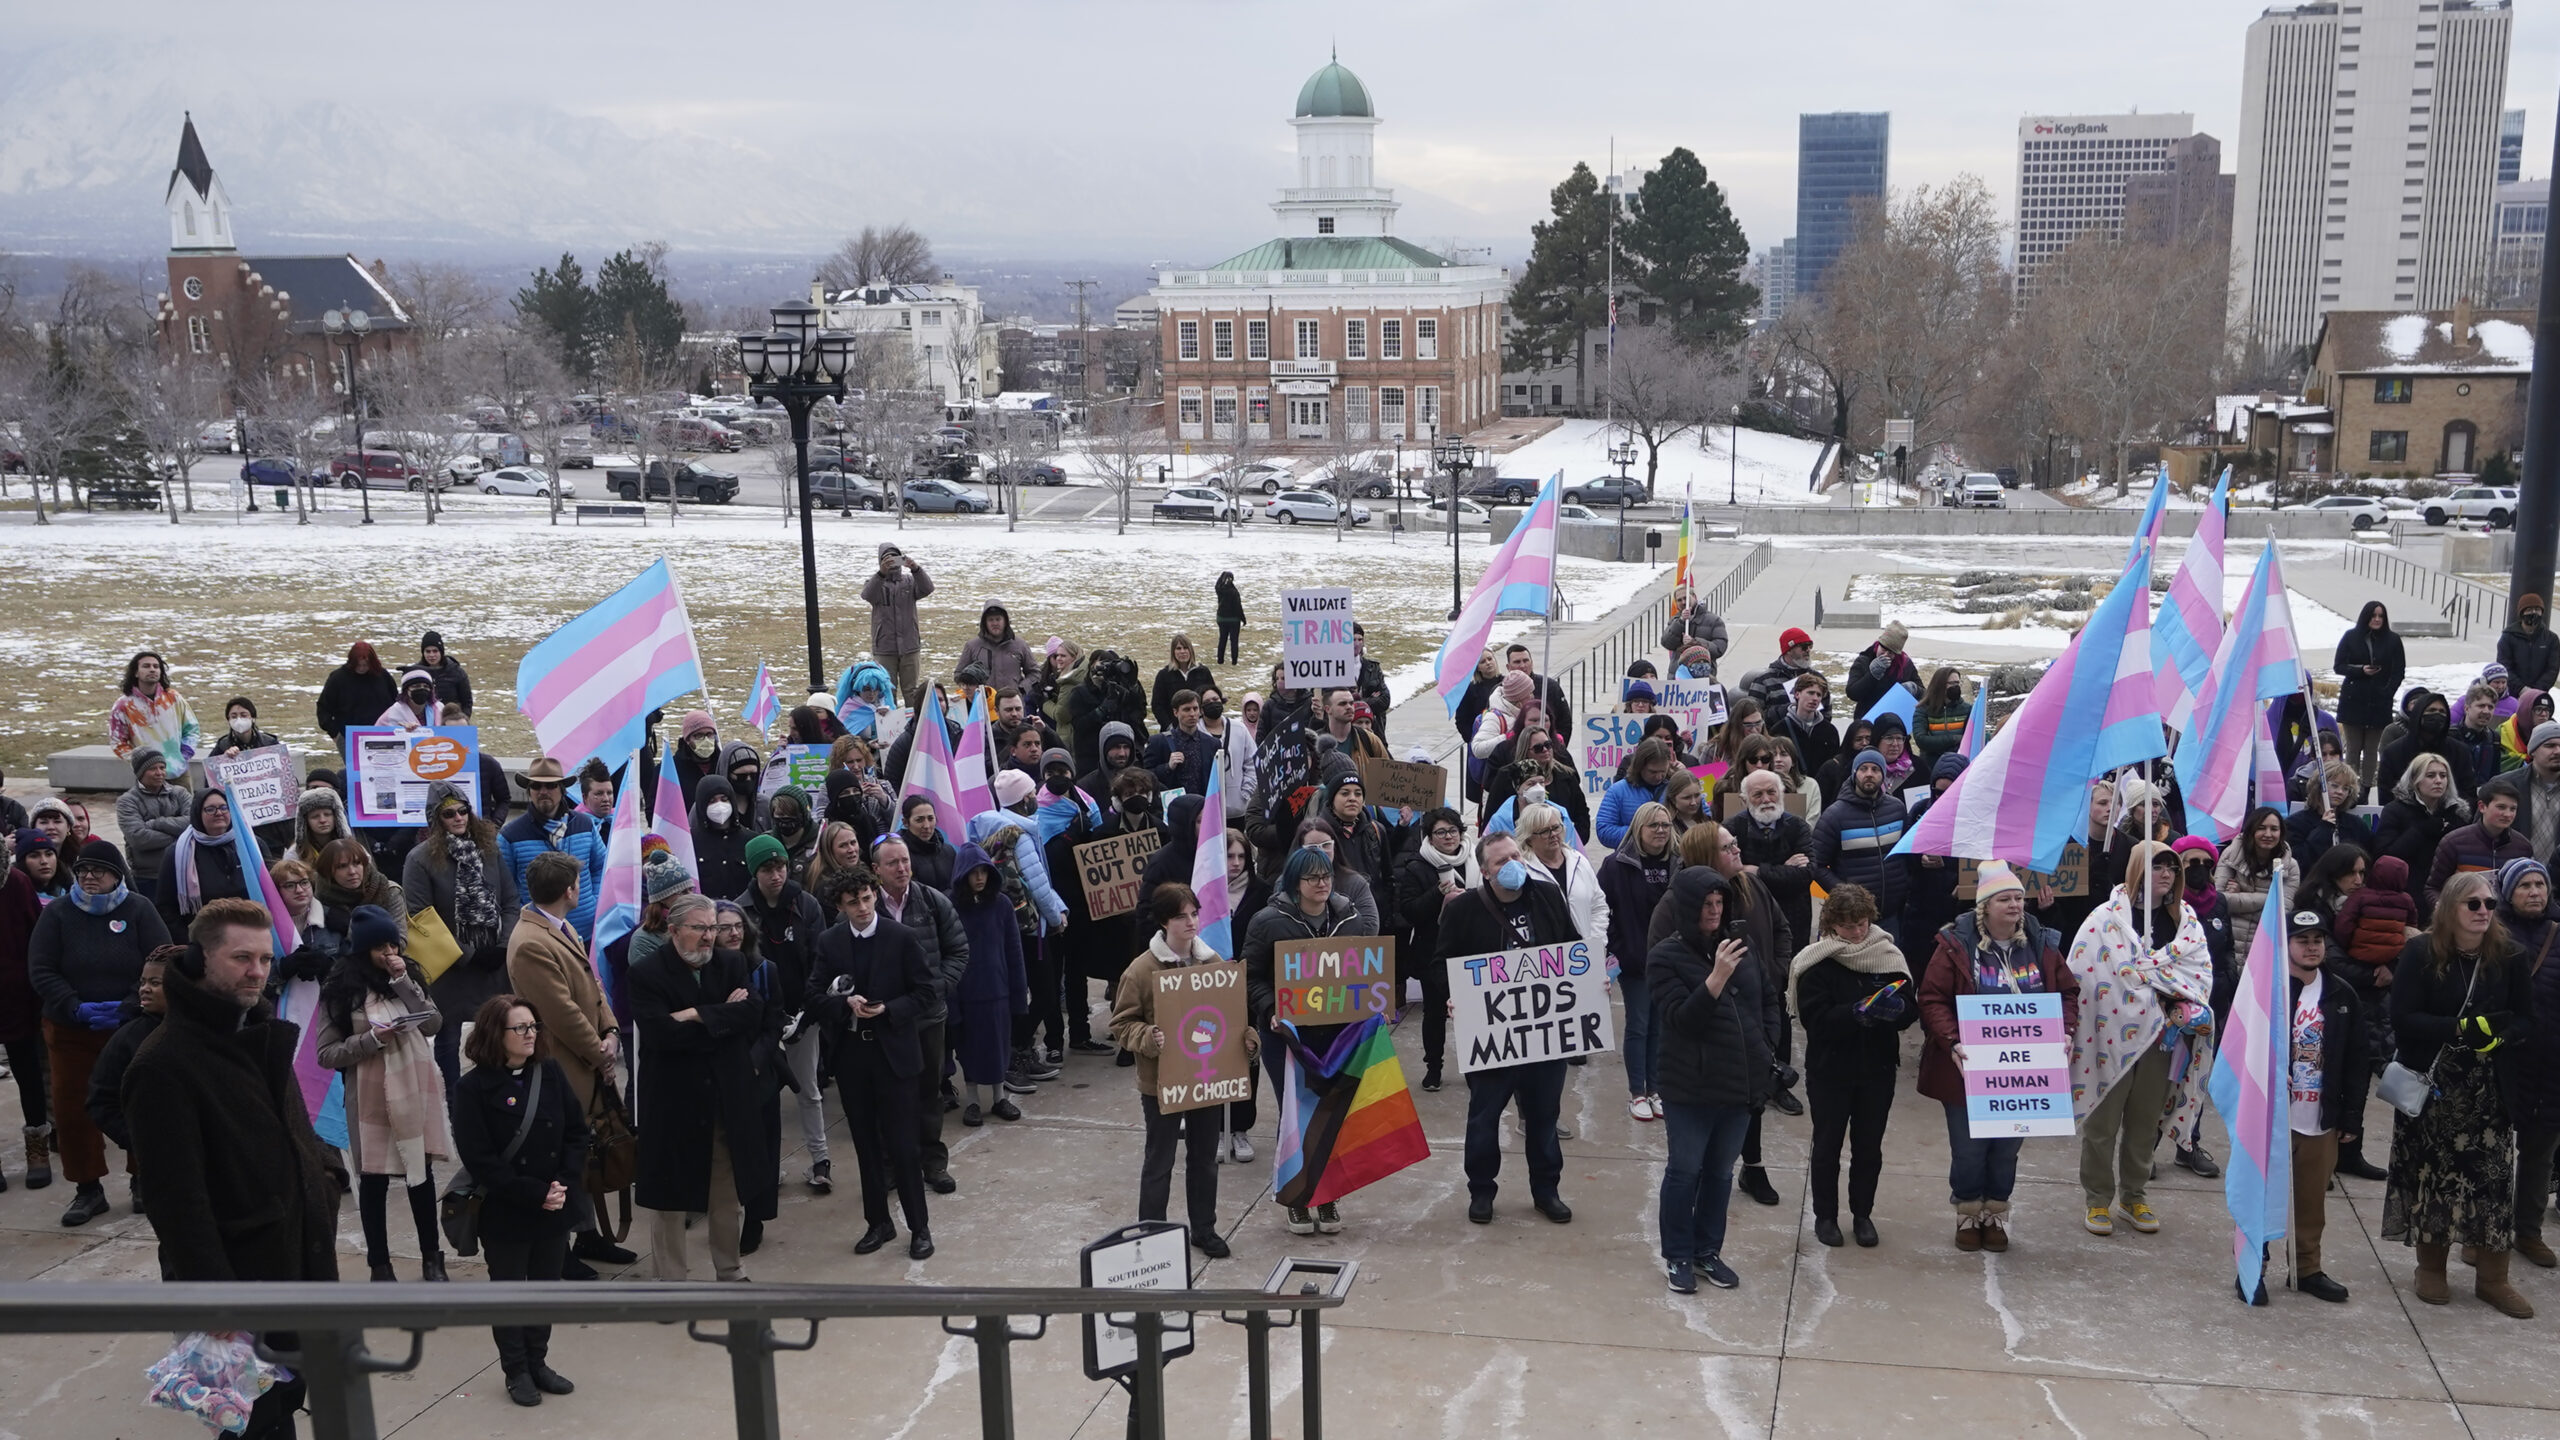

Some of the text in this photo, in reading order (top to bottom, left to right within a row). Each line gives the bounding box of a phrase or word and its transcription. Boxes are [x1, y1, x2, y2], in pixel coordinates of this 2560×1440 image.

[2055, 123, 2108, 136] KeyBank
[1215, 389, 1234, 397] GIFTS
[1288, 597, 1347, 612] VALIDATE
[1287, 619, 1354, 645] TRANS
[1290, 660, 1345, 677] YOUTH
[1586, 715, 1650, 746] Sto
[224, 758, 276, 776] PROTECT
[1587, 745, 1638, 769] Kill
[239, 783, 277, 800] TRANS
[1585, 770, 1614, 794] Tra
[251, 804, 280, 820] KIDS
[1080, 832, 1160, 866] KEEP HATE
[1087, 856, 1147, 886] OUT O
[1284, 946, 1384, 980] HUMAN
[1464, 942, 1590, 986] TRANS
[1980, 962, 2041, 988] MAMA
[1160, 969, 1238, 992] MY BODY
[1277, 981, 1391, 1018] RIGHTS
[1484, 981, 1577, 1025] KIDS
[1981, 1002, 2038, 1016] TRANS
[1469, 1012, 1604, 1066] MATTER
[1981, 1025, 2043, 1038] RIGHTS
[1998, 1050, 2031, 1063] ARE
[1162, 1077, 1248, 1104] MY CHOICE
[1985, 1075, 2049, 1088] HUMAN
[1989, 1098, 2050, 1112] RIGHTS
[1107, 1260, 1172, 1285] SOUTH DOORS
